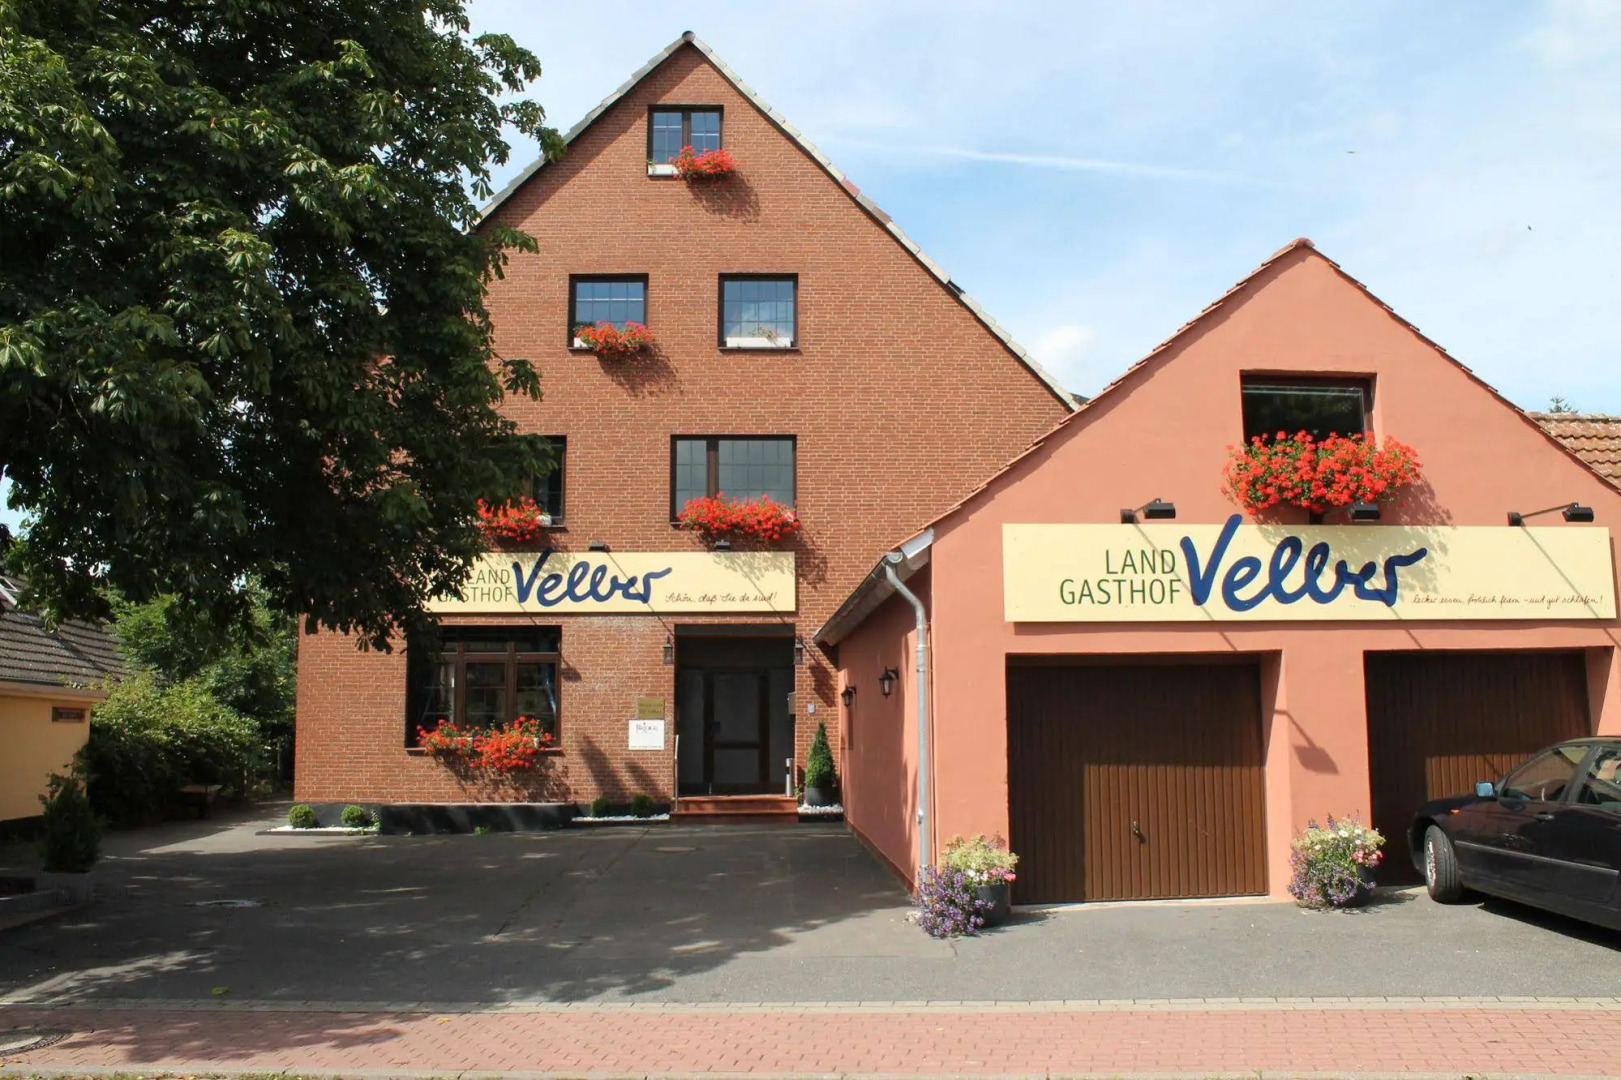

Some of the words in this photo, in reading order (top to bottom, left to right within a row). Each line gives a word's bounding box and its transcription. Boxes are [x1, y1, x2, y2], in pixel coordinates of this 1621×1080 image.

[1105, 549, 1176, 575] LAND
[1179, 513, 1428, 612] Velber
[511, 547, 673, 607] Velber
[438, 586, 513, 603] STHOF
[738, 592, 750, 603] da
[1059, 578, 1182, 605] GASTHOF
[1546, 595, 1560, 610] gut
